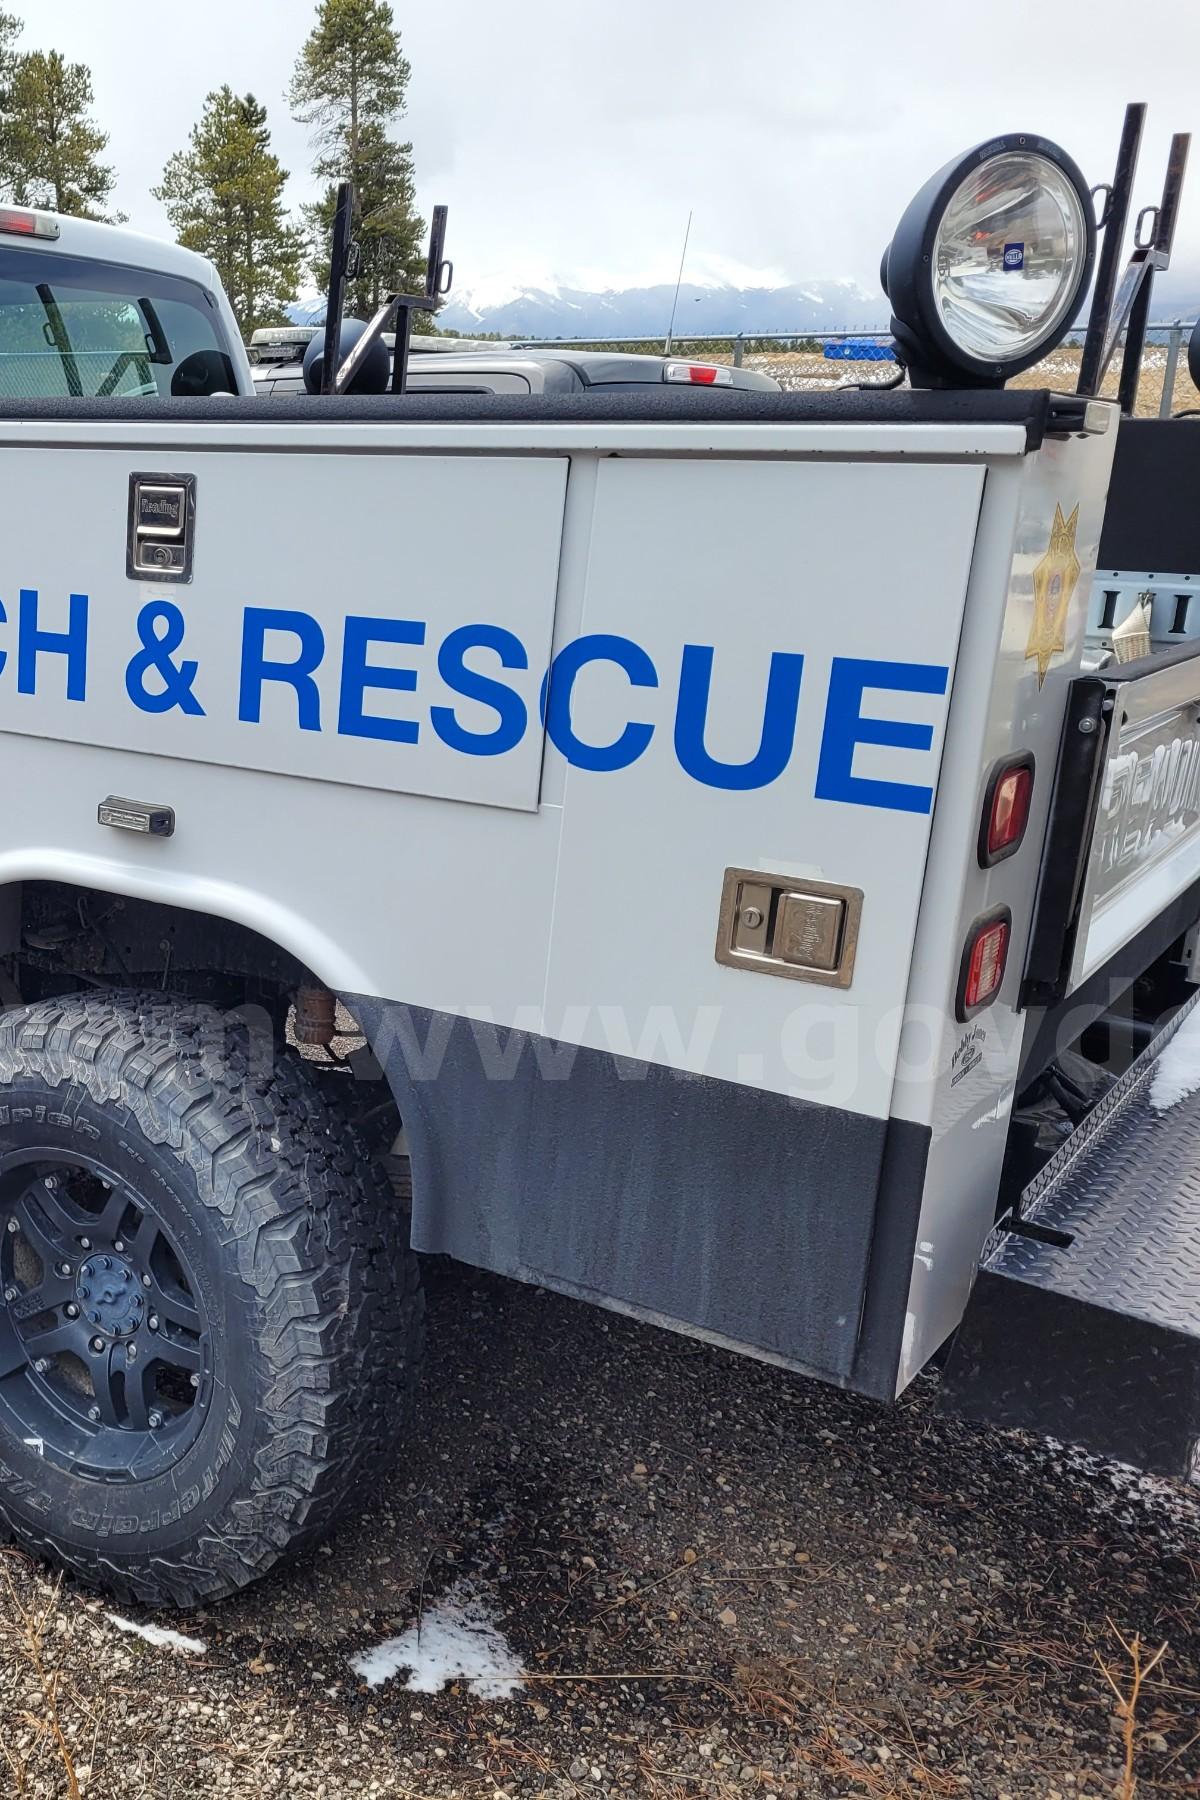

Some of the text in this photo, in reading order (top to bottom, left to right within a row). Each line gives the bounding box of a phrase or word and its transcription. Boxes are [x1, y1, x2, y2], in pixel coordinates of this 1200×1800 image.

[141, 498, 179, 518] Reading
[125, 599, 207, 716] &
[238, 606, 950, 815] RESCUE
[71, 1384, 242, 1538] All-Terrain
